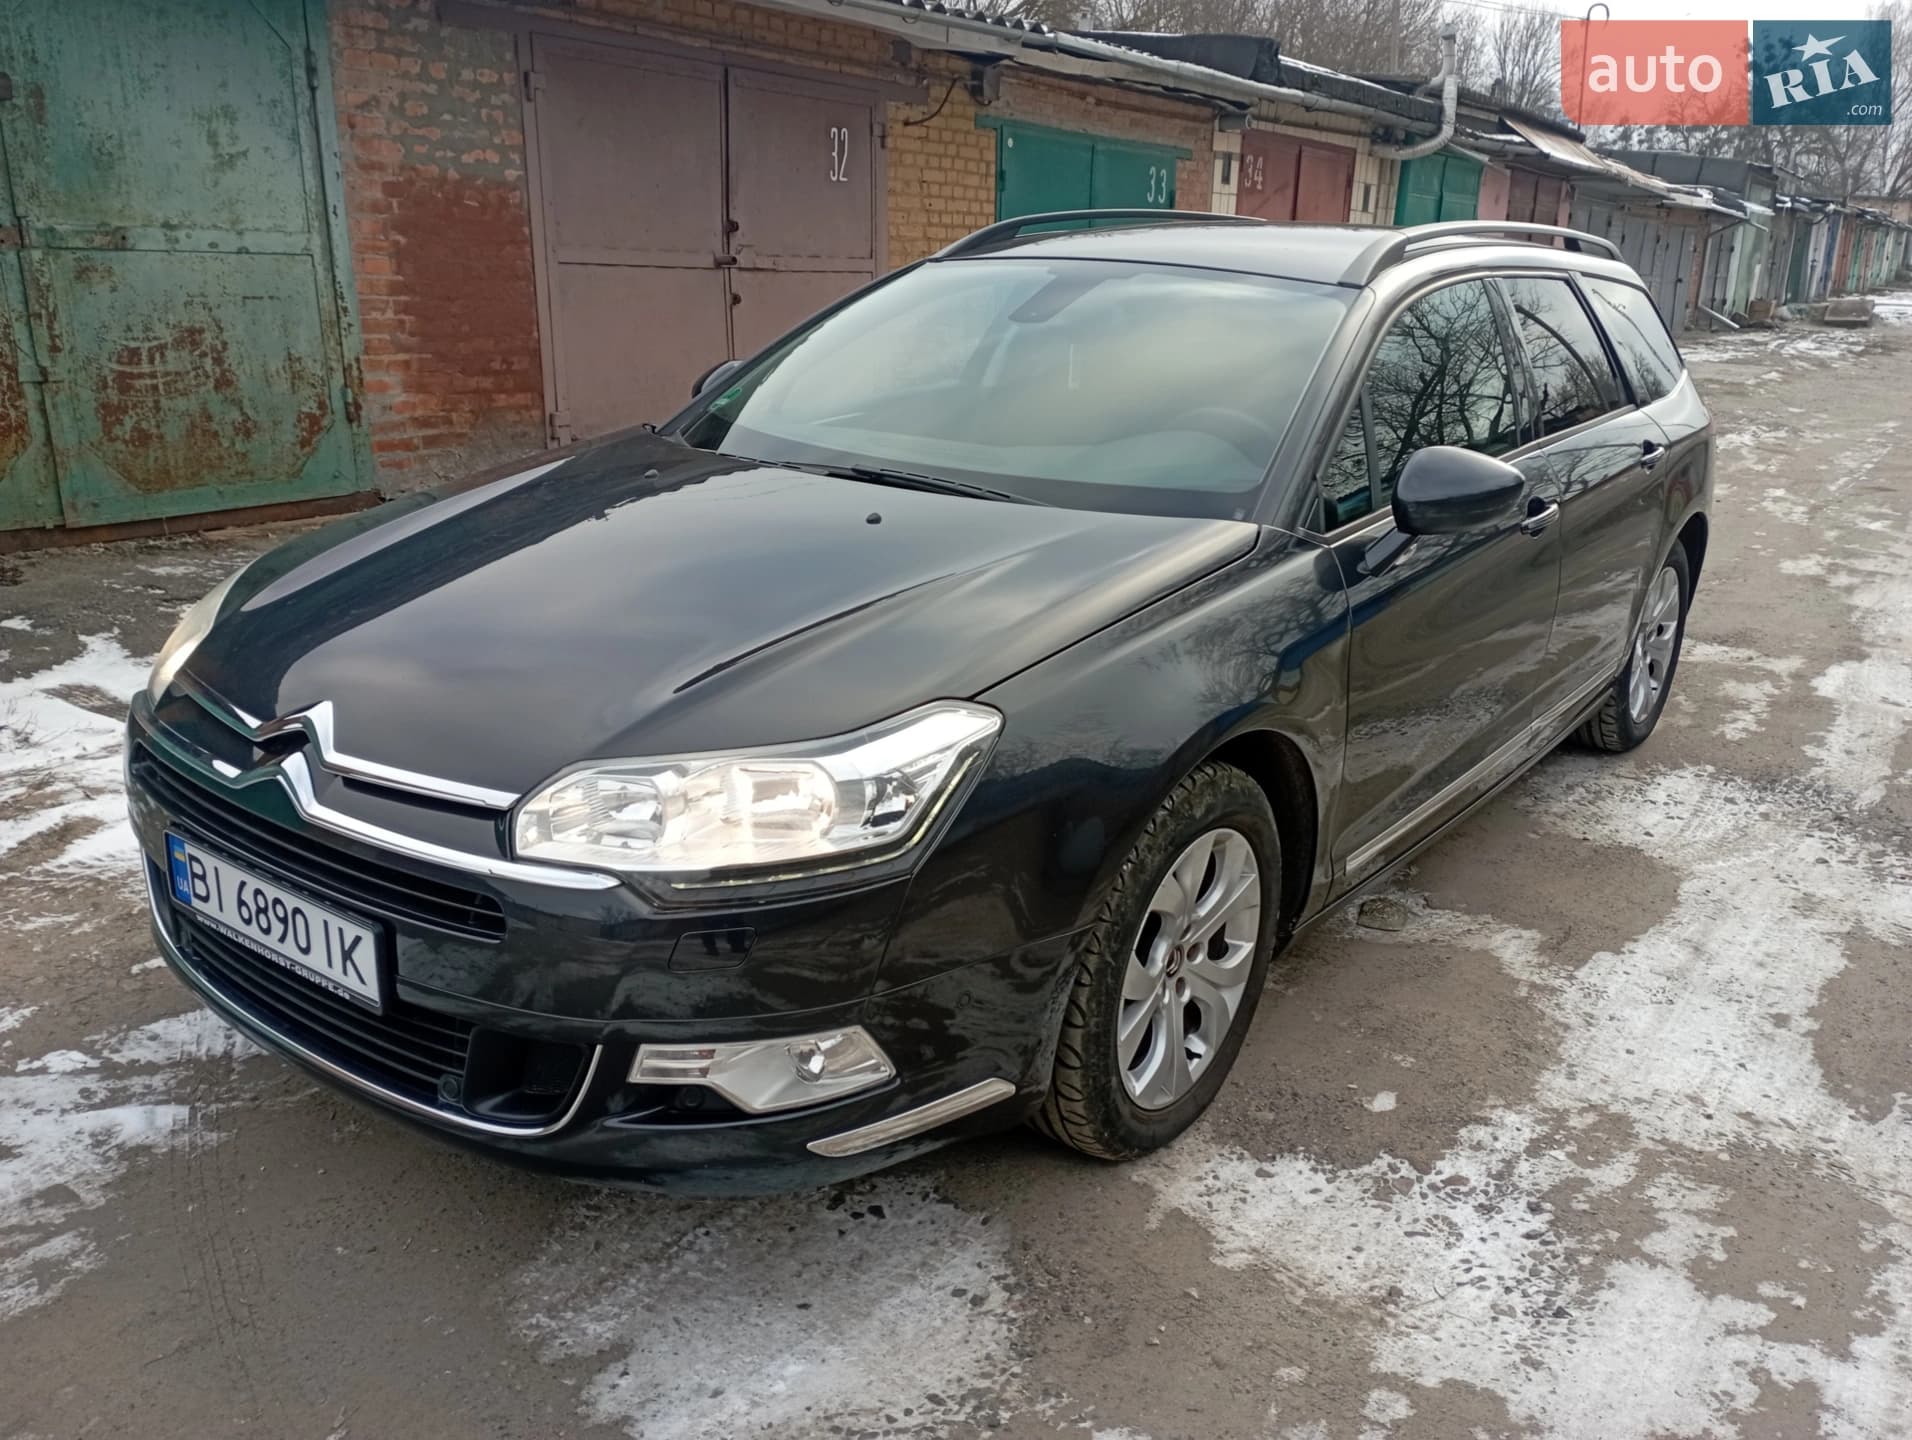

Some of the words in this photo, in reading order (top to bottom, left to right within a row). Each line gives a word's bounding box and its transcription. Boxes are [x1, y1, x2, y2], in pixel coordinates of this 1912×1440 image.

[830, 127, 848, 181] 32
[1245, 155, 1263, 190] 34
[1147, 166, 1167, 203] 33
[176, 877, 190, 894] UA
[187, 852, 223, 913] BI
[237, 880, 311, 956] 6890
[323, 919, 367, 986] IK
